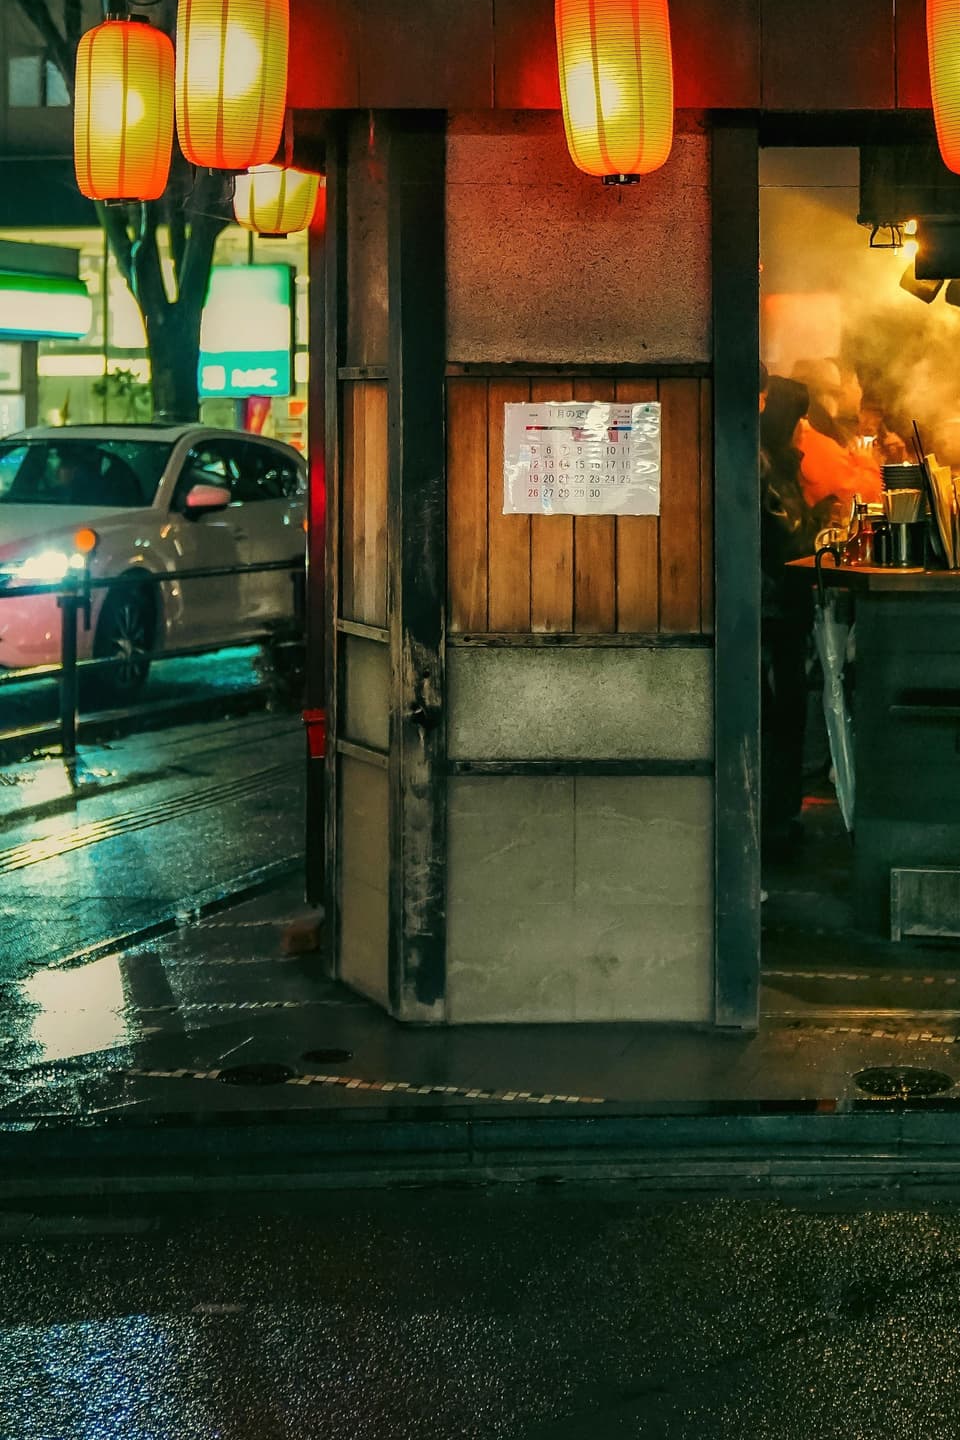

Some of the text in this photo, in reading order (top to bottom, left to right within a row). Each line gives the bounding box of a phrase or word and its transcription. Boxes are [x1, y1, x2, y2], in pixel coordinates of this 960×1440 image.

[606, 447, 616, 455] 10
[544, 460, 554, 469] 13
[606, 460, 615, 469] 17
[529, 475, 539, 483] 19
[543, 475, 554, 483] 20
[589, 475, 600, 483] 23
[605, 475, 615, 483] 24
[528, 489, 538, 498] 26
[543, 489, 554, 498] 27
[558, 489, 569, 498] 28
[589, 489, 600, 498] 30
